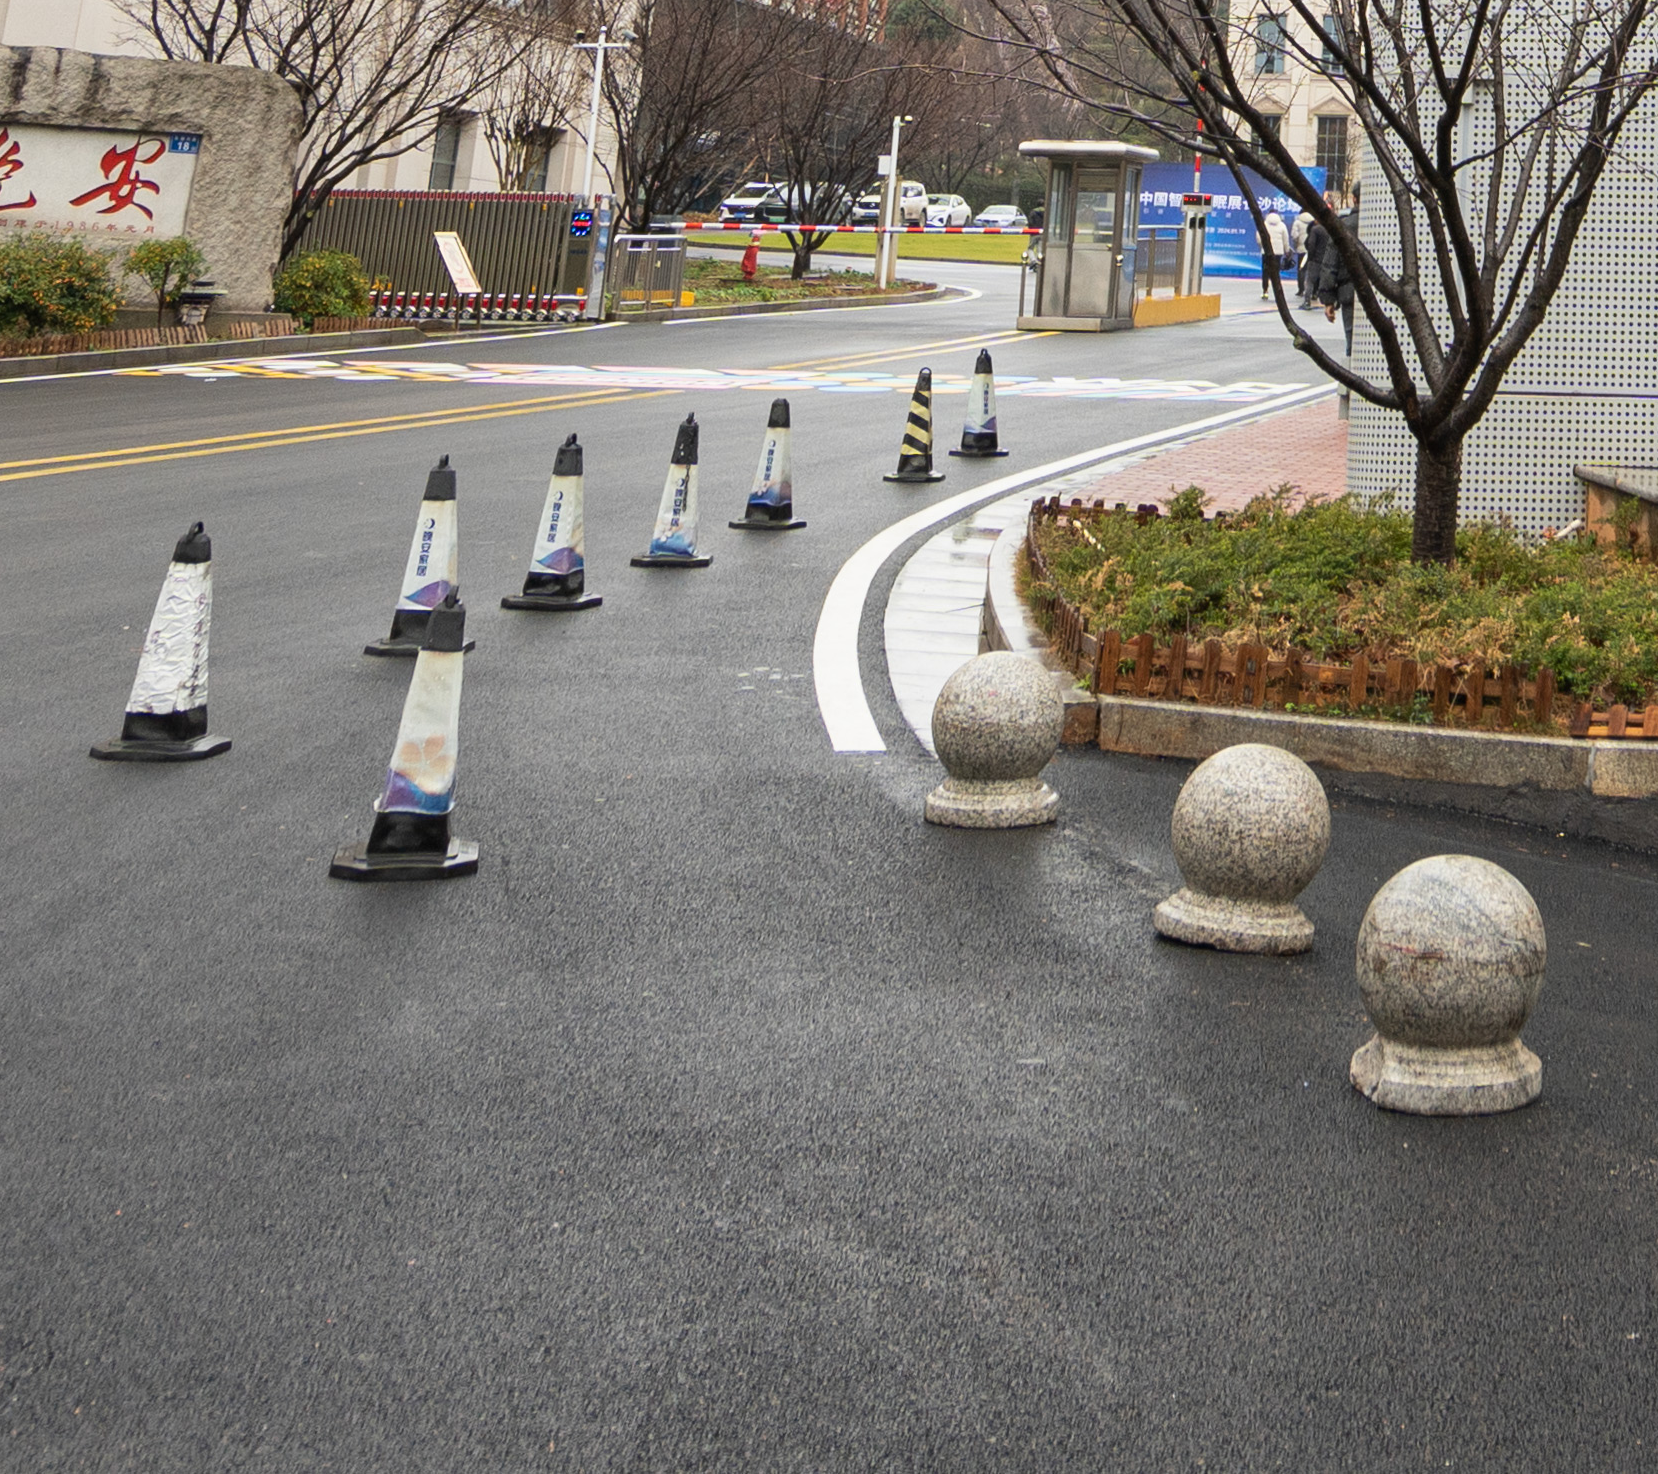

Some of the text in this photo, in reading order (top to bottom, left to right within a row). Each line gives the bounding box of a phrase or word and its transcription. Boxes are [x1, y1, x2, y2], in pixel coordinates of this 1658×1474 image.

[177, 141, 190, 151] 18
[547, 502, 562, 543] 晚安家居
[416, 530, 434, 577] 晚安家居
